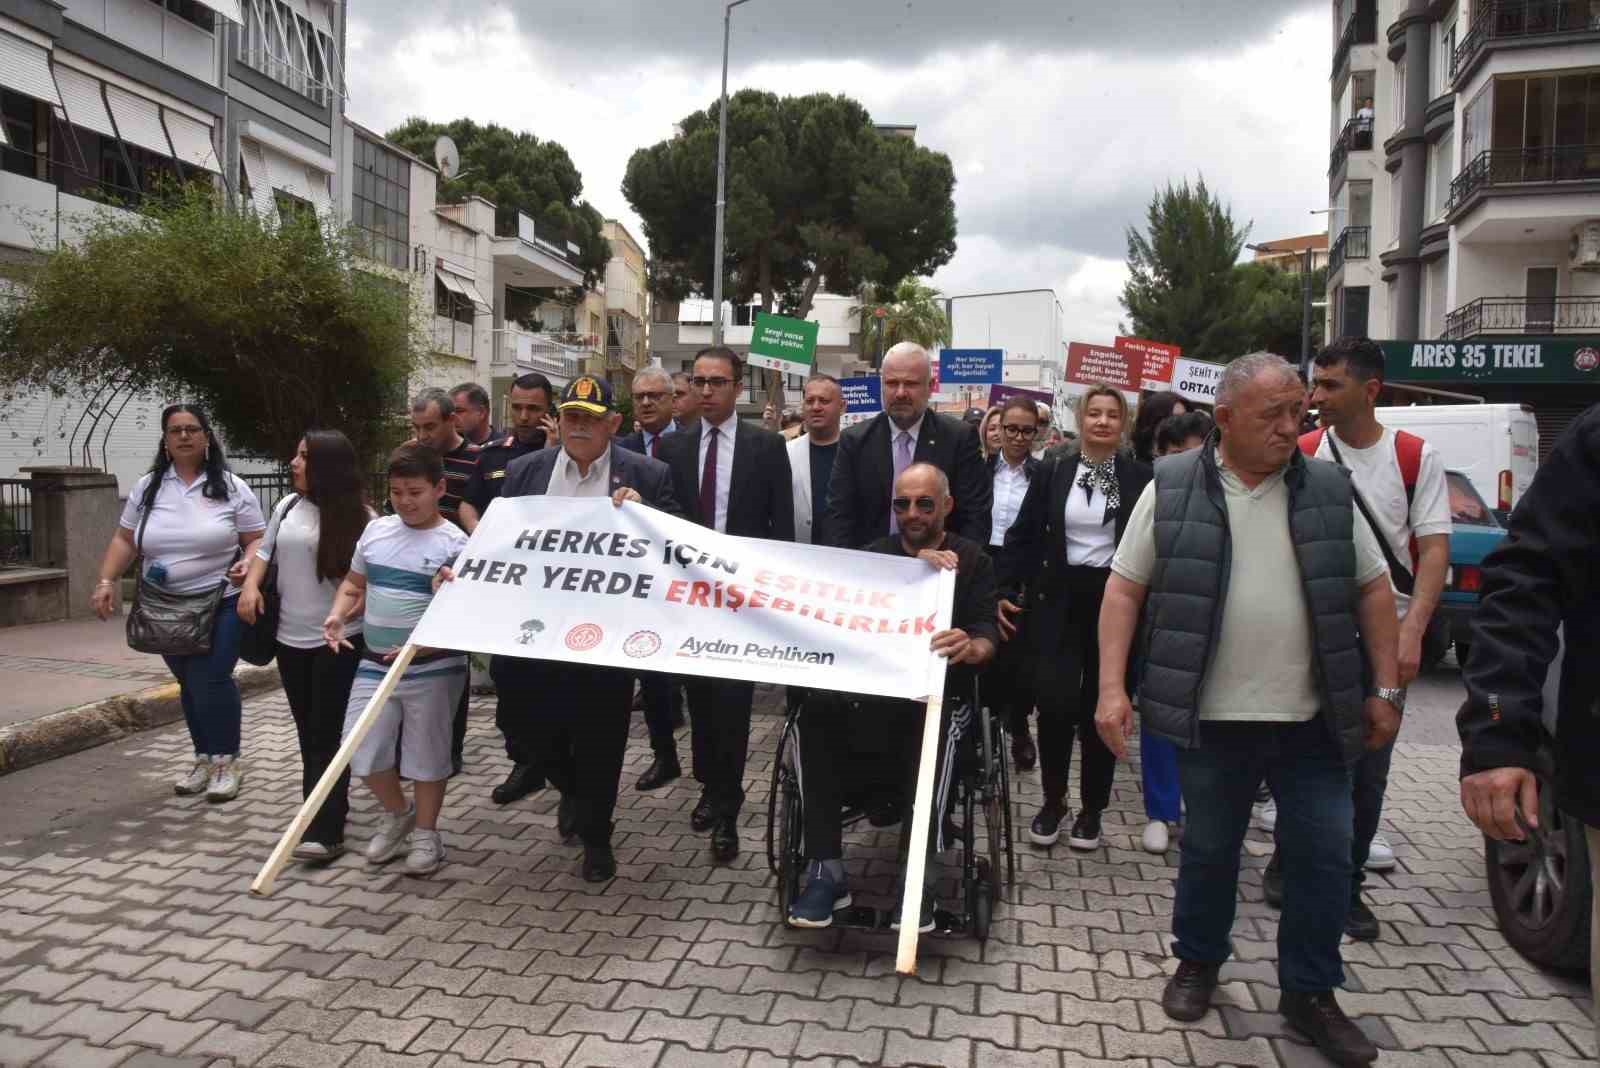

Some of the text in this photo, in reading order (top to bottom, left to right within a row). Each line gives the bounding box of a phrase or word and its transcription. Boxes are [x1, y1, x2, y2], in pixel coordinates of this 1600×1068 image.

[1411, 343, 1545, 368] ARES 35 TEKEL
[514, 528, 651, 559] HERKES
[457, 558, 528, 586] HER
[542, 565, 654, 599] YERDE
[680, 636, 738, 656] Aydın
[743, 642, 835, 666] Pehlivan
